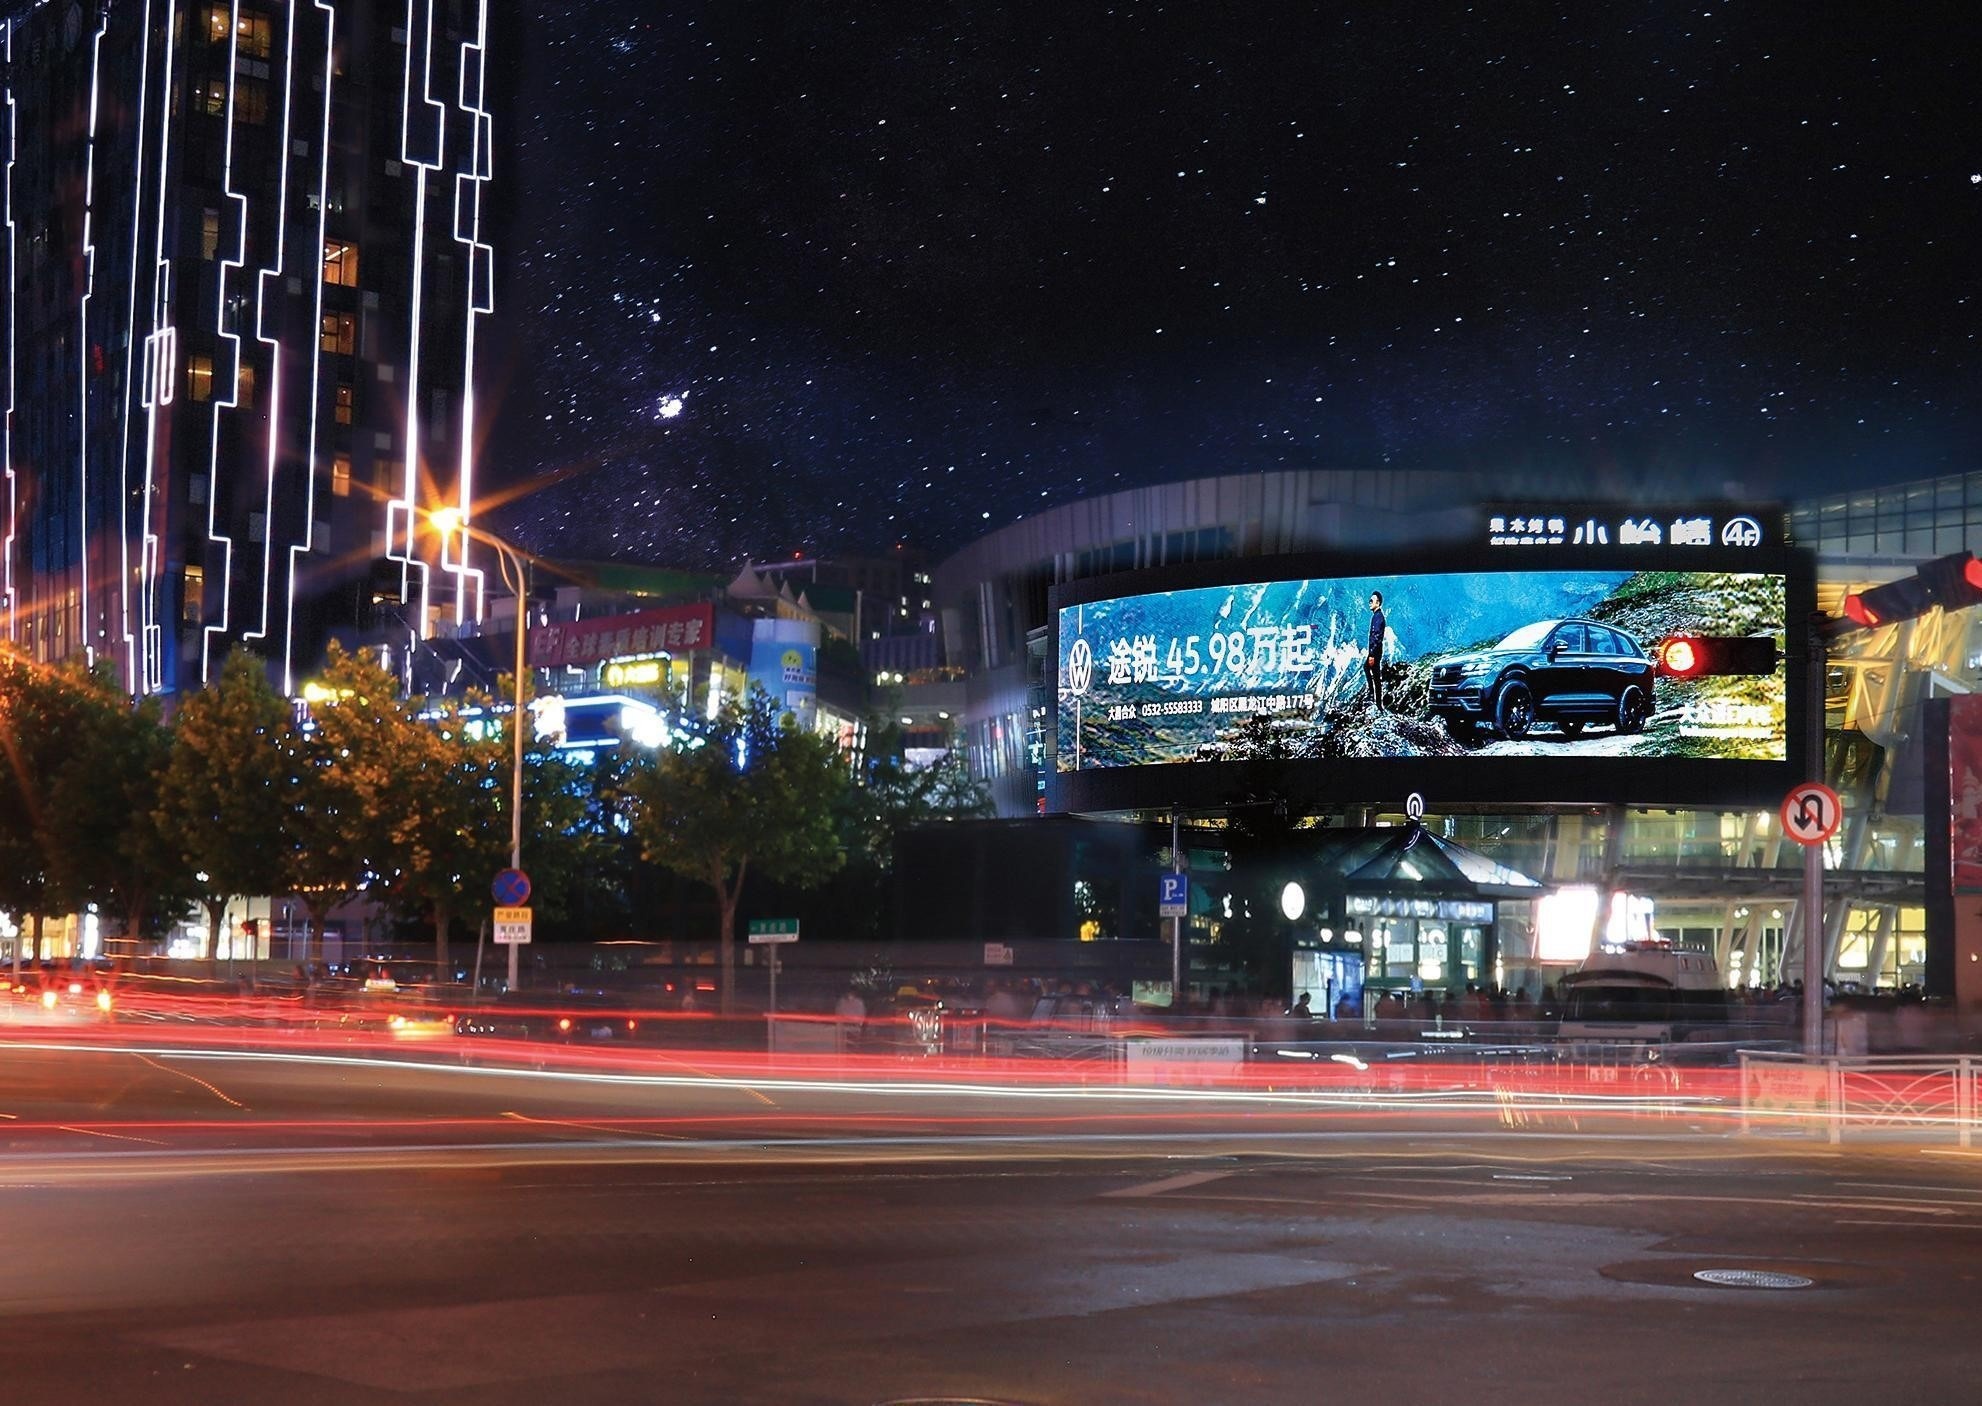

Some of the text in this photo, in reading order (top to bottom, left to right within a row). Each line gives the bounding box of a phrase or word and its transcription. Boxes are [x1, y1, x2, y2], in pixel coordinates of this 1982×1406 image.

[1107, 623, 1315, 685] 途锐 45.98万起
[1142, 700, 1203, 717] 0532-55583333
